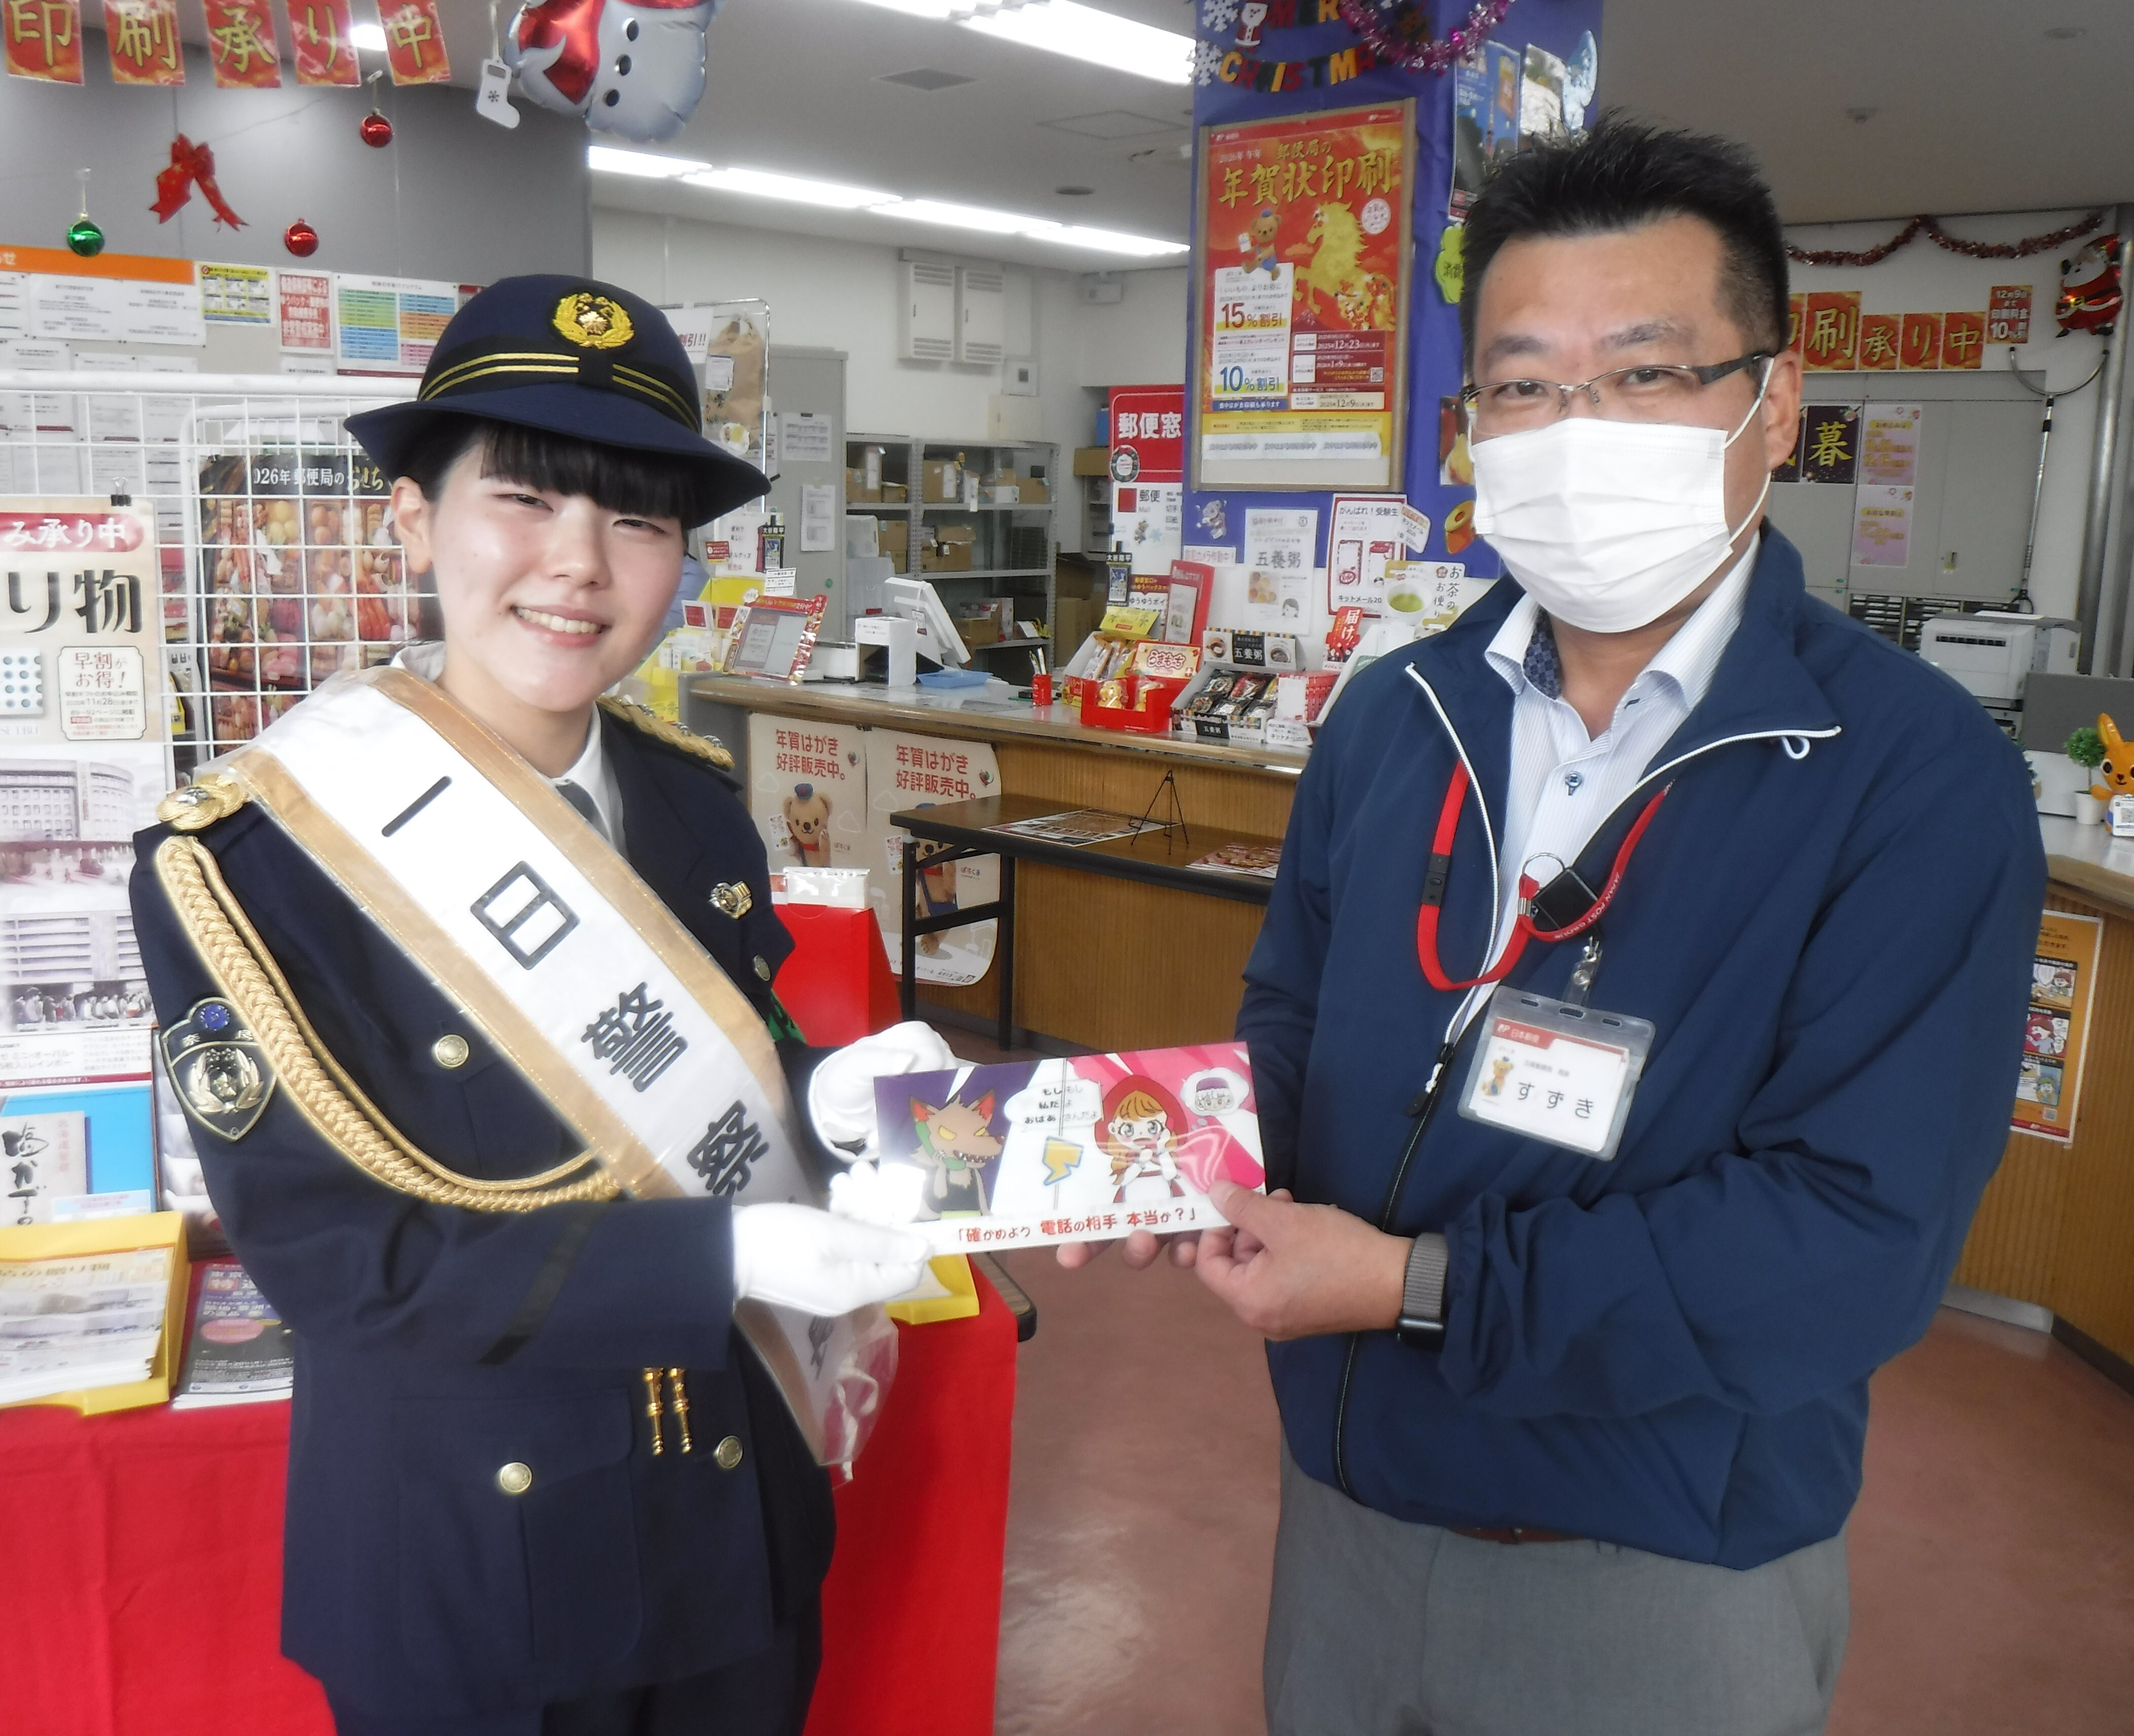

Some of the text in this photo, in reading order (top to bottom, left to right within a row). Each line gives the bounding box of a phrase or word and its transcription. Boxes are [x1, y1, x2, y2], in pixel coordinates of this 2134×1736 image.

[1220, 45, 1388, 93] CHRISTMA
[1277, 138, 1332, 160] 郵便局の
[1219, 148, 1393, 209] 年賀状印刷
[1118, 412, 1182, 440] 郵便窓
[1787, 421, 1853, 468] 暮
[1139, 489, 1161, 503] 郵便
[1339, 507, 1398, 517] がんばれ！受験生
[4, 517, 127, 549] み承り中
[1255, 550, 1301, 568] 五養粥
[8, 569, 143, 634] り物
[1433, 583, 1445, 618] お便り
[1446, 566, 1462, 609] お茶の
[776, 728, 839, 756] 年賀はがき
[776, 753, 845, 781] 好評販売中。
[896, 744, 969, 775] 年賀はがき
[896, 769, 976, 800] 好評販売中。
[1586, 901, 1606, 924] POST
[1517, 1081, 1594, 1120] すずき
[958, 1208, 1197, 1243] 「確かめよう 電話の相手 本当か？」
